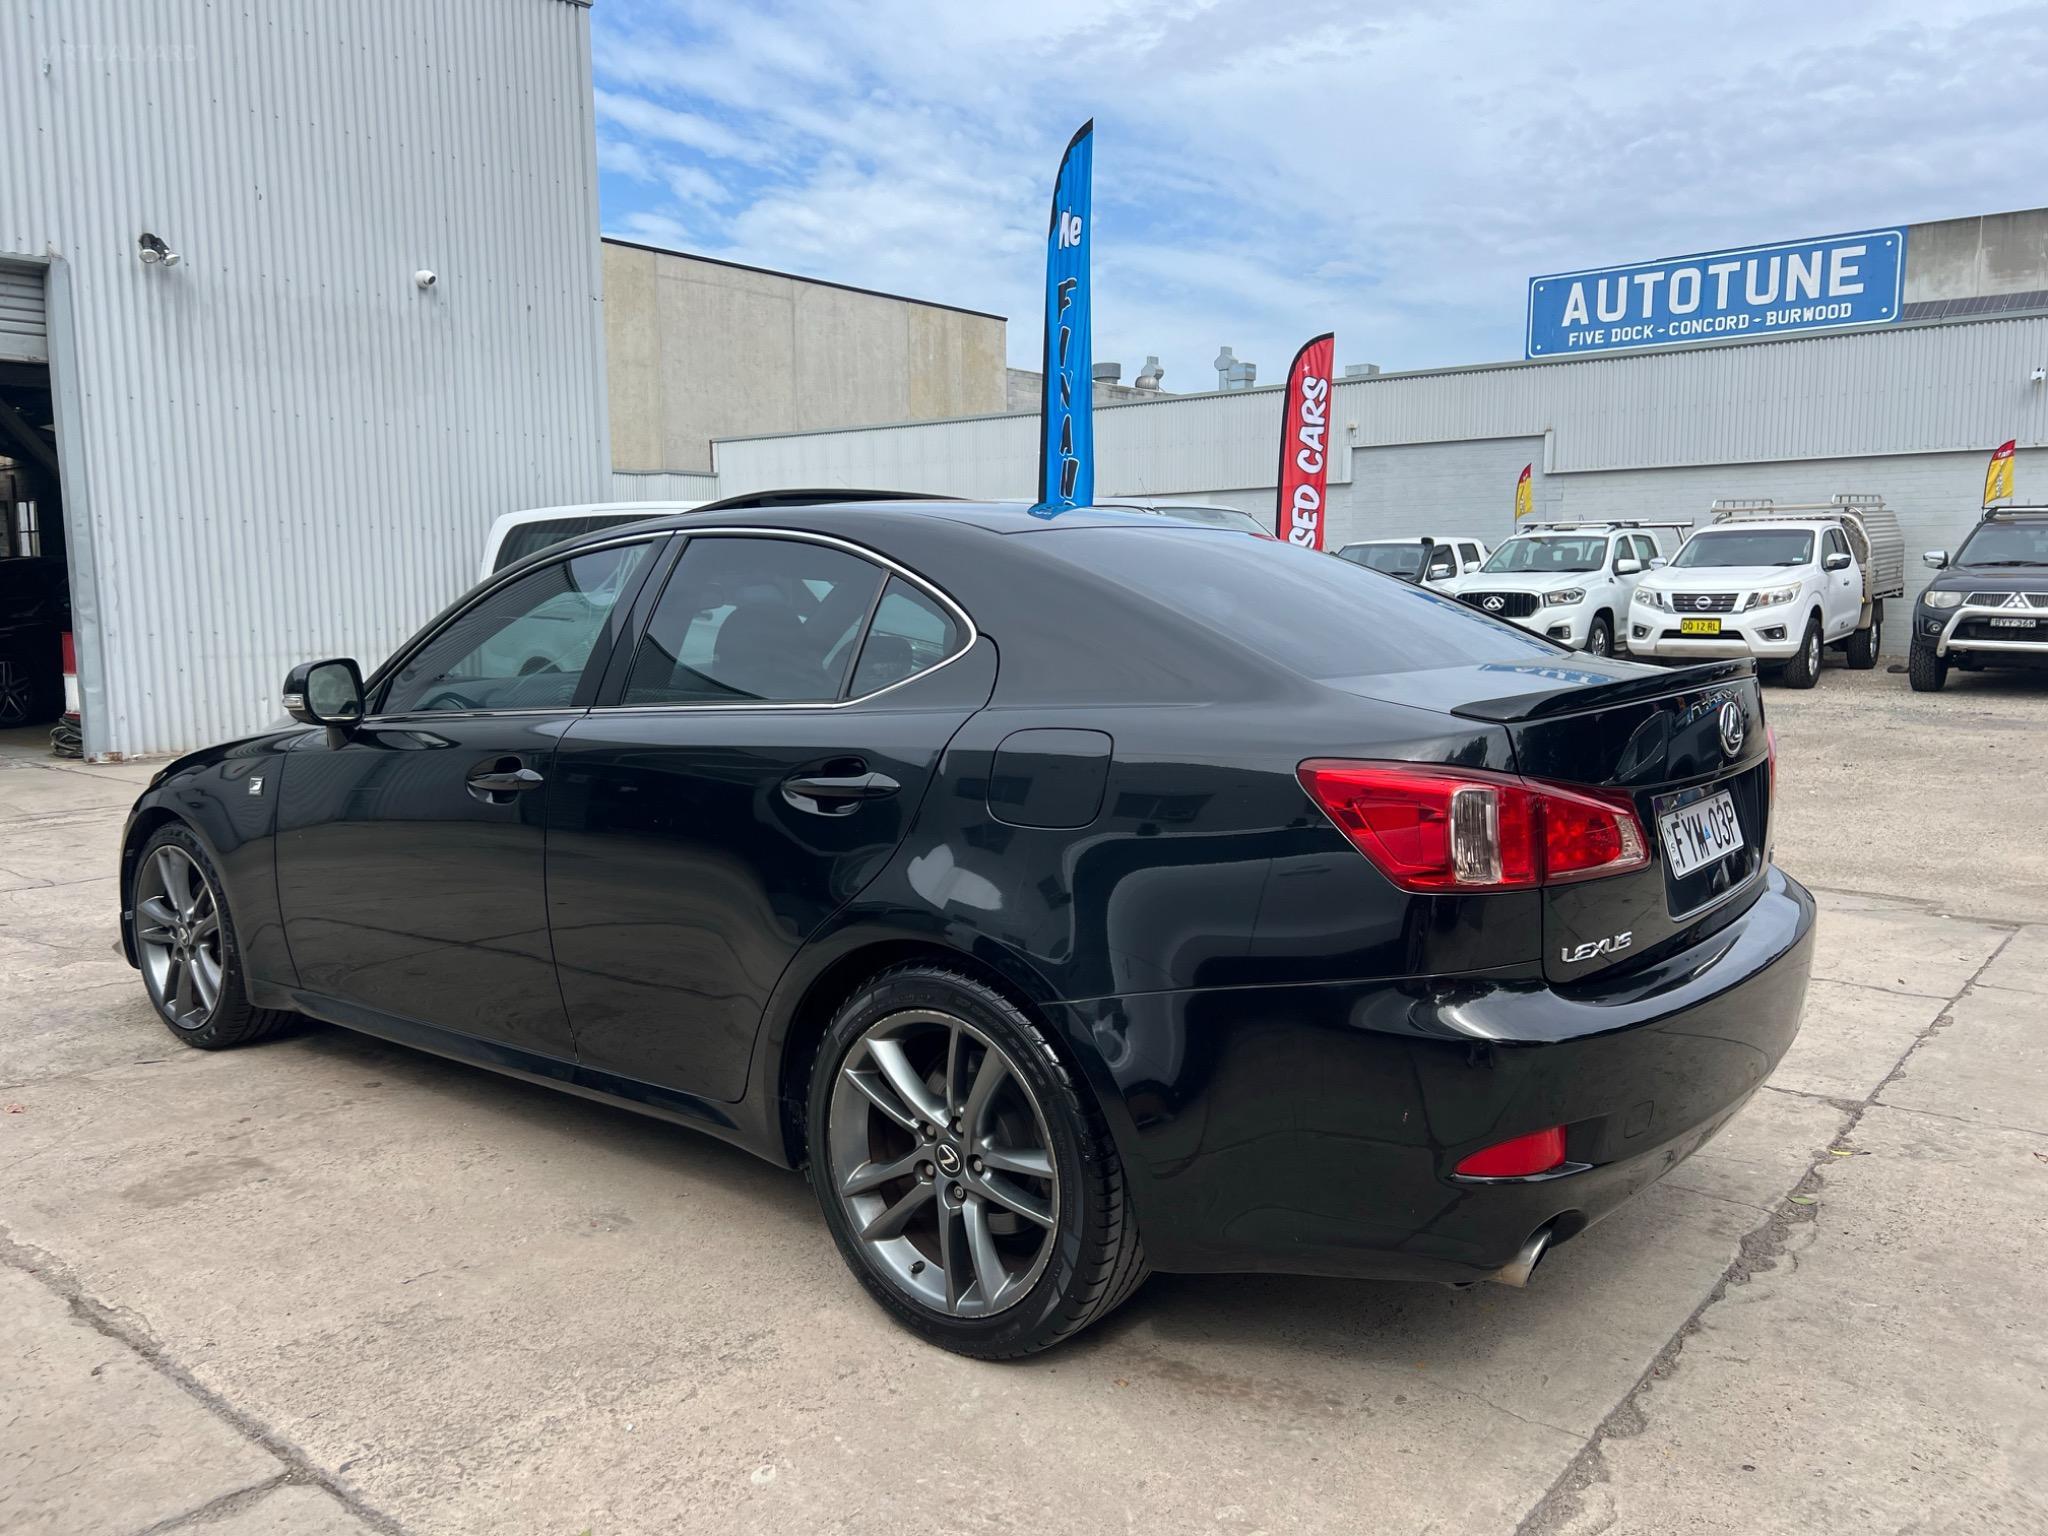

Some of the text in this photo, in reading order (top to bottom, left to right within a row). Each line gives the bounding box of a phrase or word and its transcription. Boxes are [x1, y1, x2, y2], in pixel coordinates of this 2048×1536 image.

[1561, 245, 1867, 327] AUTOTUNE
[1569, 329, 1604, 346] FIVE
[1288, 376, 1328, 549] SED CARS
[1562, 931, 1632, 962] LEXUS
